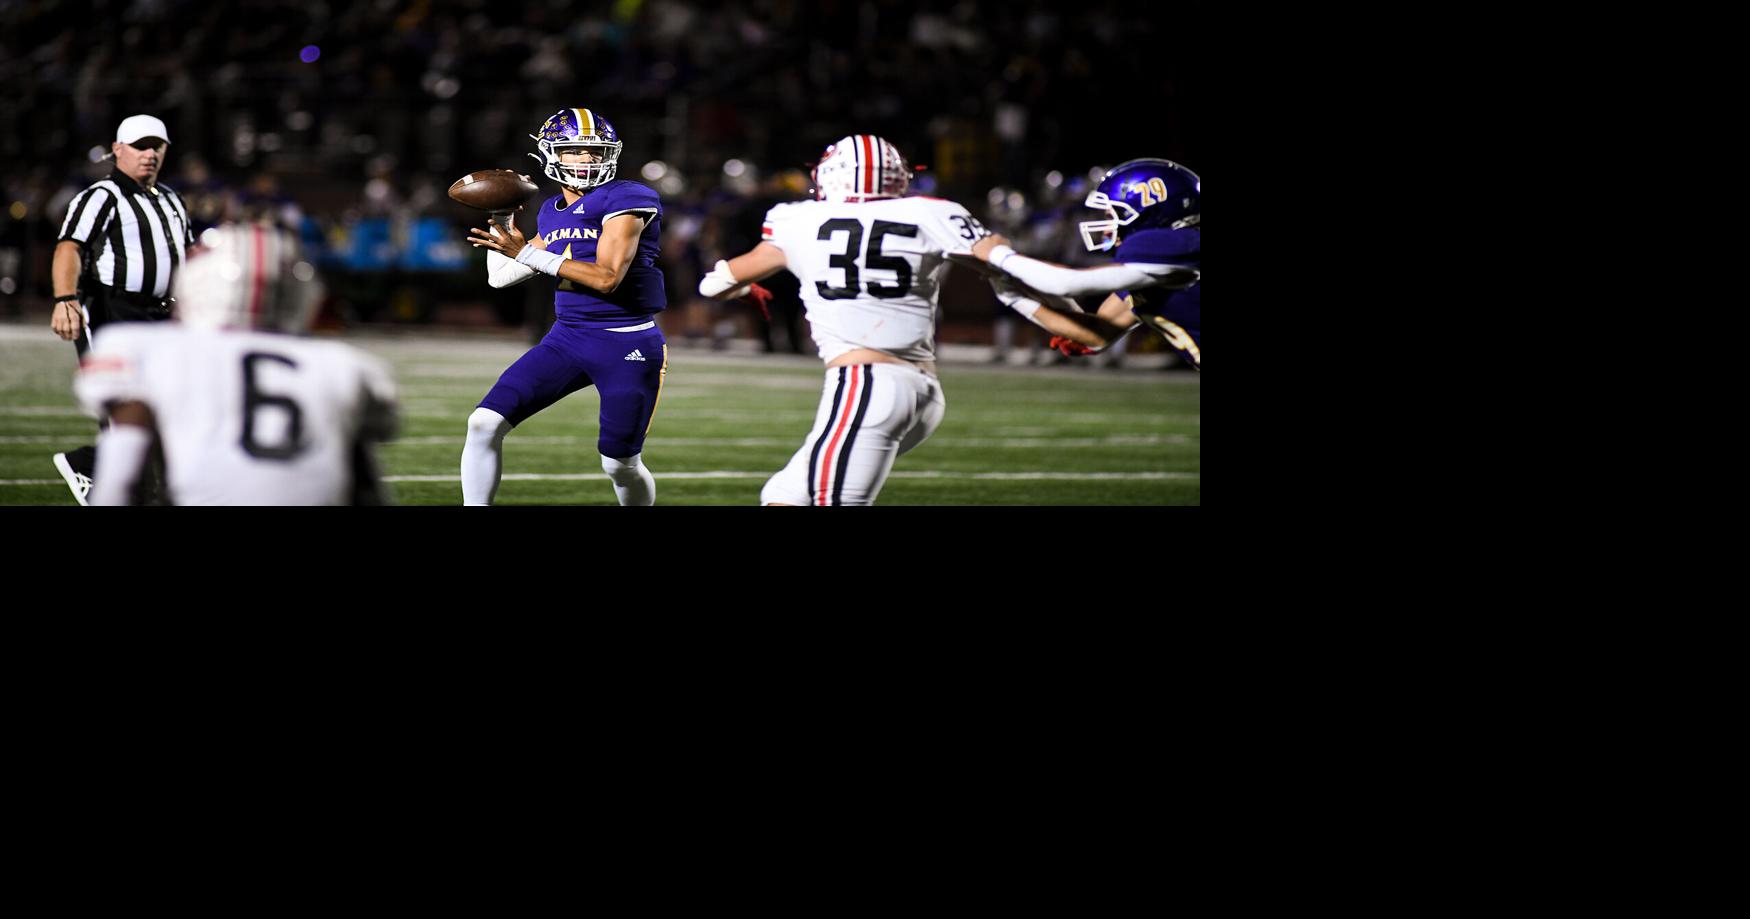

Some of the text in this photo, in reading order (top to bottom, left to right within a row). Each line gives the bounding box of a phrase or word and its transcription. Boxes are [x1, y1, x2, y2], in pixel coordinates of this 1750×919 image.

[1134, 177, 1168, 207] 29
[544, 228, 598, 247] CKMAN
[815, 218, 918, 300] 35
[241, 352, 307, 460] 6
